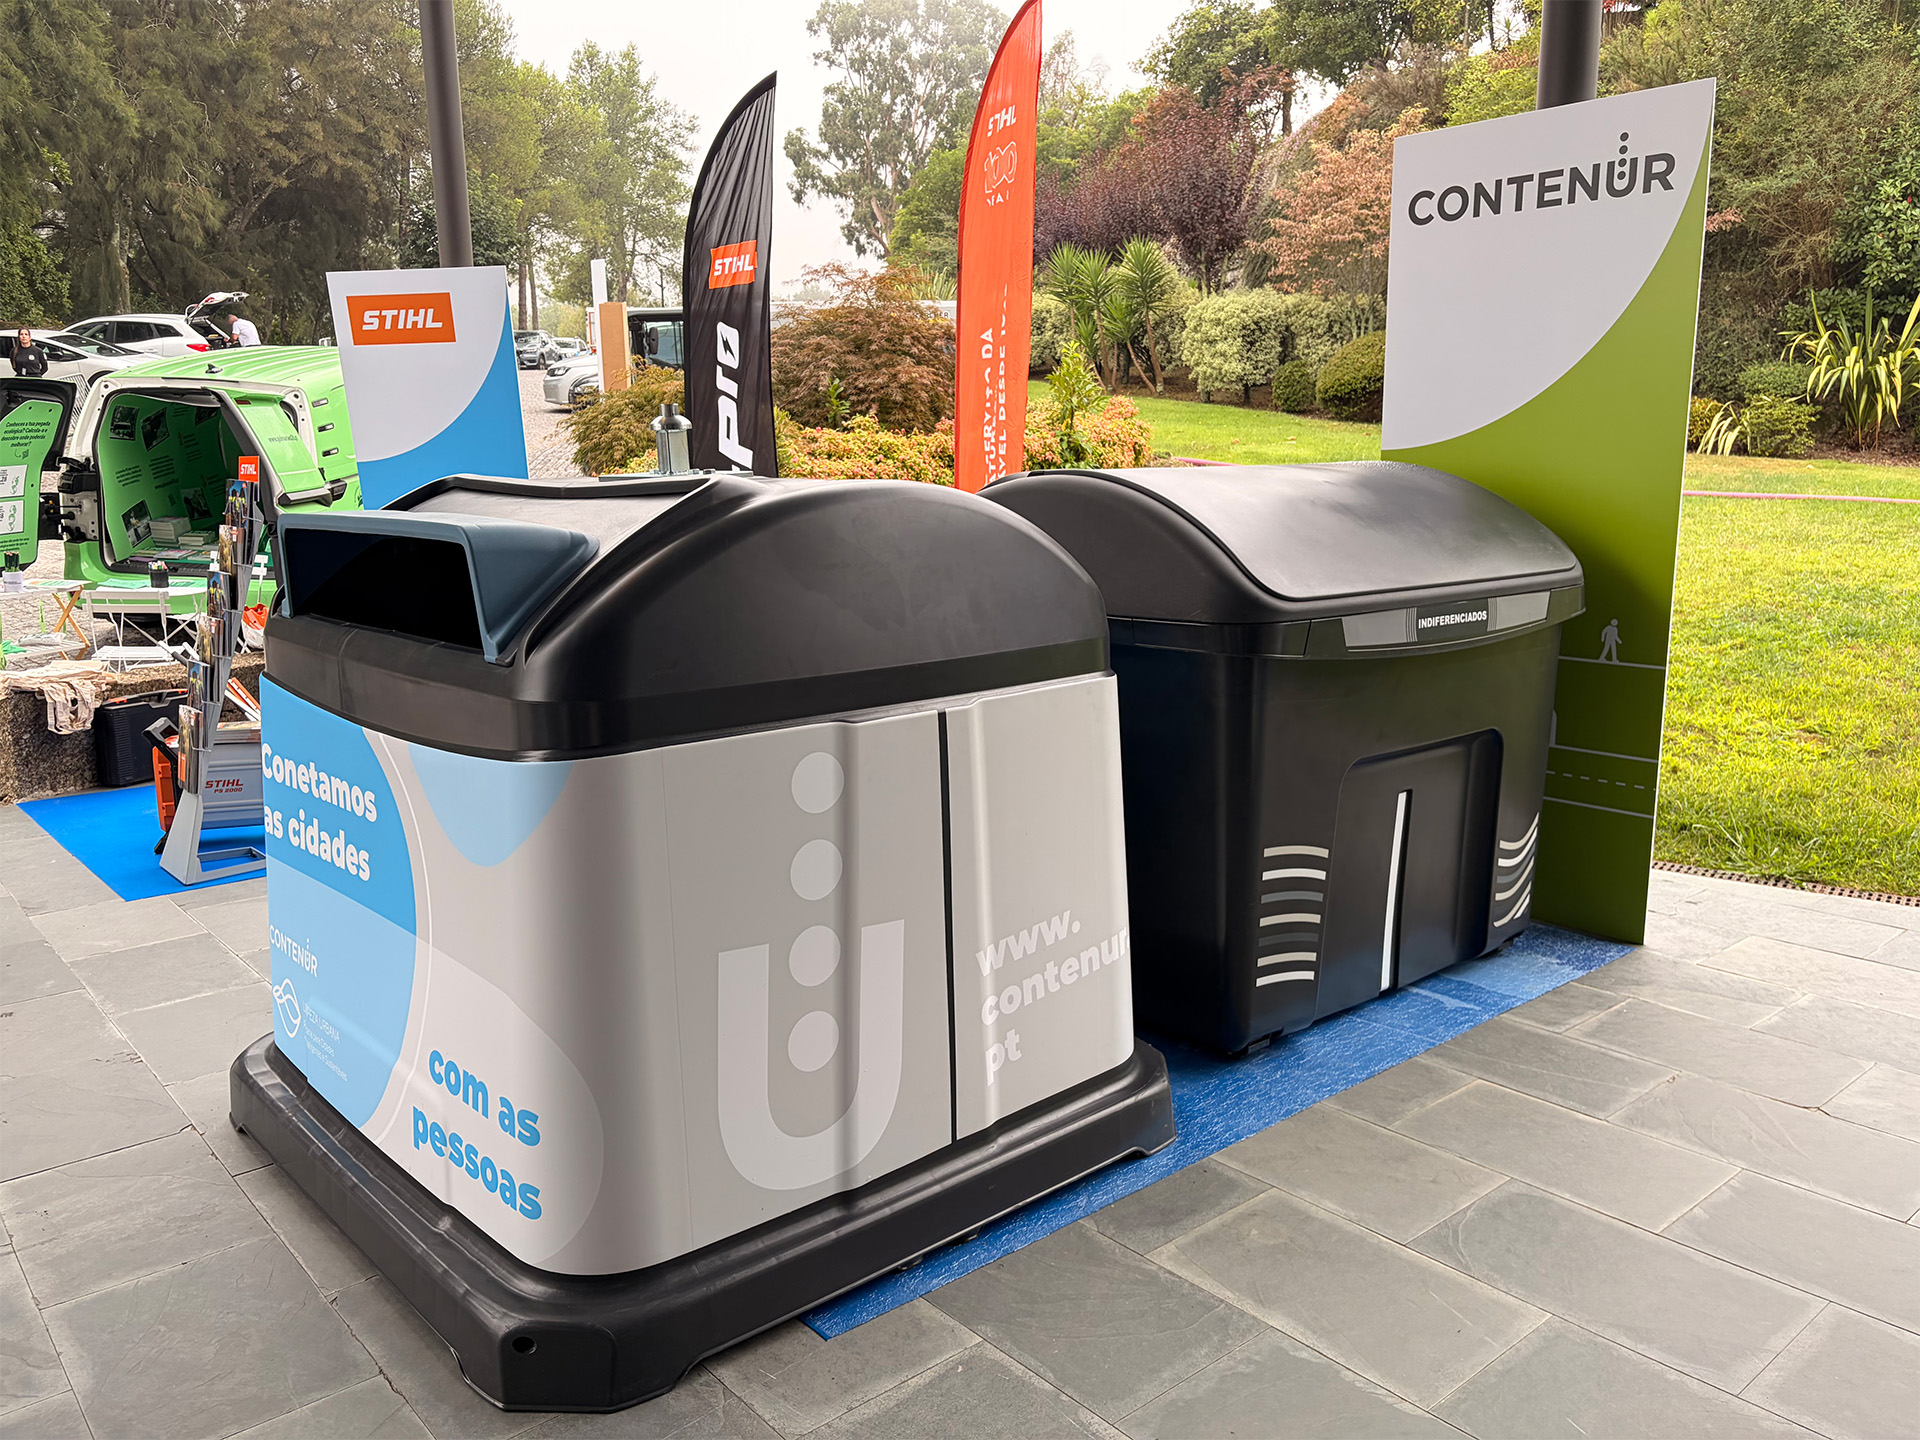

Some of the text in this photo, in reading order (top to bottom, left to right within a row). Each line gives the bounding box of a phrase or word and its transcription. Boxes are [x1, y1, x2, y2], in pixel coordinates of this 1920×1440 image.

[986, 104, 1017, 138] STHL
[713, 253, 754, 277] STIHL
[362, 308, 443, 331] STIHL
[979, 327, 994, 360] DA
[240, 463, 257, 475] STIHL
[1418, 610, 1487, 629] INDIFERENCIADOS
[204, 778, 244, 789] STIHL
[261, 743, 377, 823] Conetamos
[264, 805, 371, 882] as cidades
[975, 910, 1081, 977] www.
[981, 927, 1130, 1026] contenur
[985, 1029, 1022, 1086] pt
[429, 1049, 541, 1147] com as
[412, 1105, 543, 1220] pessoas
